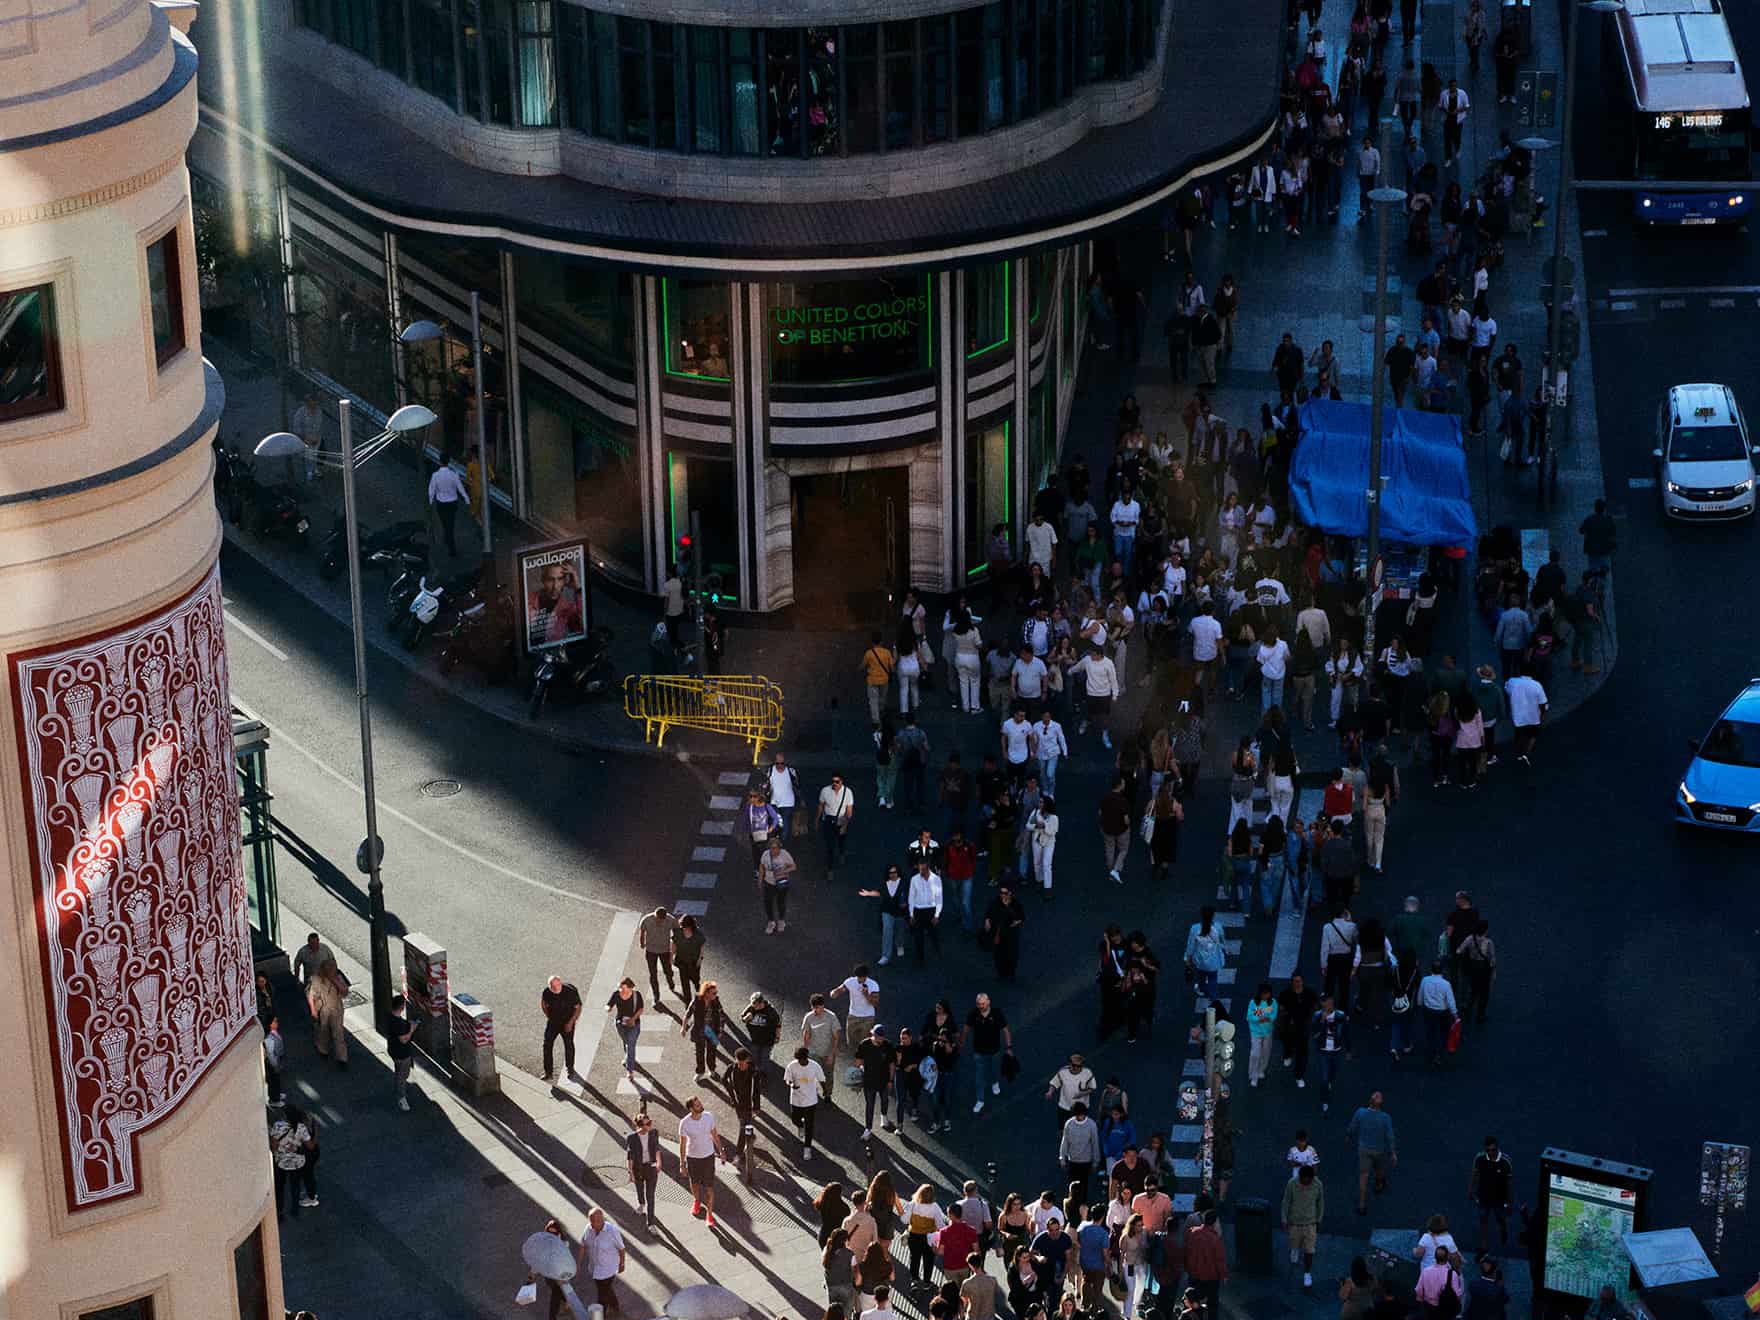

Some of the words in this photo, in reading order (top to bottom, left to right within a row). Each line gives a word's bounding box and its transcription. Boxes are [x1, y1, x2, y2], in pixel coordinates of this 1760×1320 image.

[1655, 116, 1672, 129] 146
[776, 305, 848, 324] UNITED
[853, 296, 927, 318] COLORS
[776, 328, 806, 345] OF
[525, 549, 581, 568] wallapop
